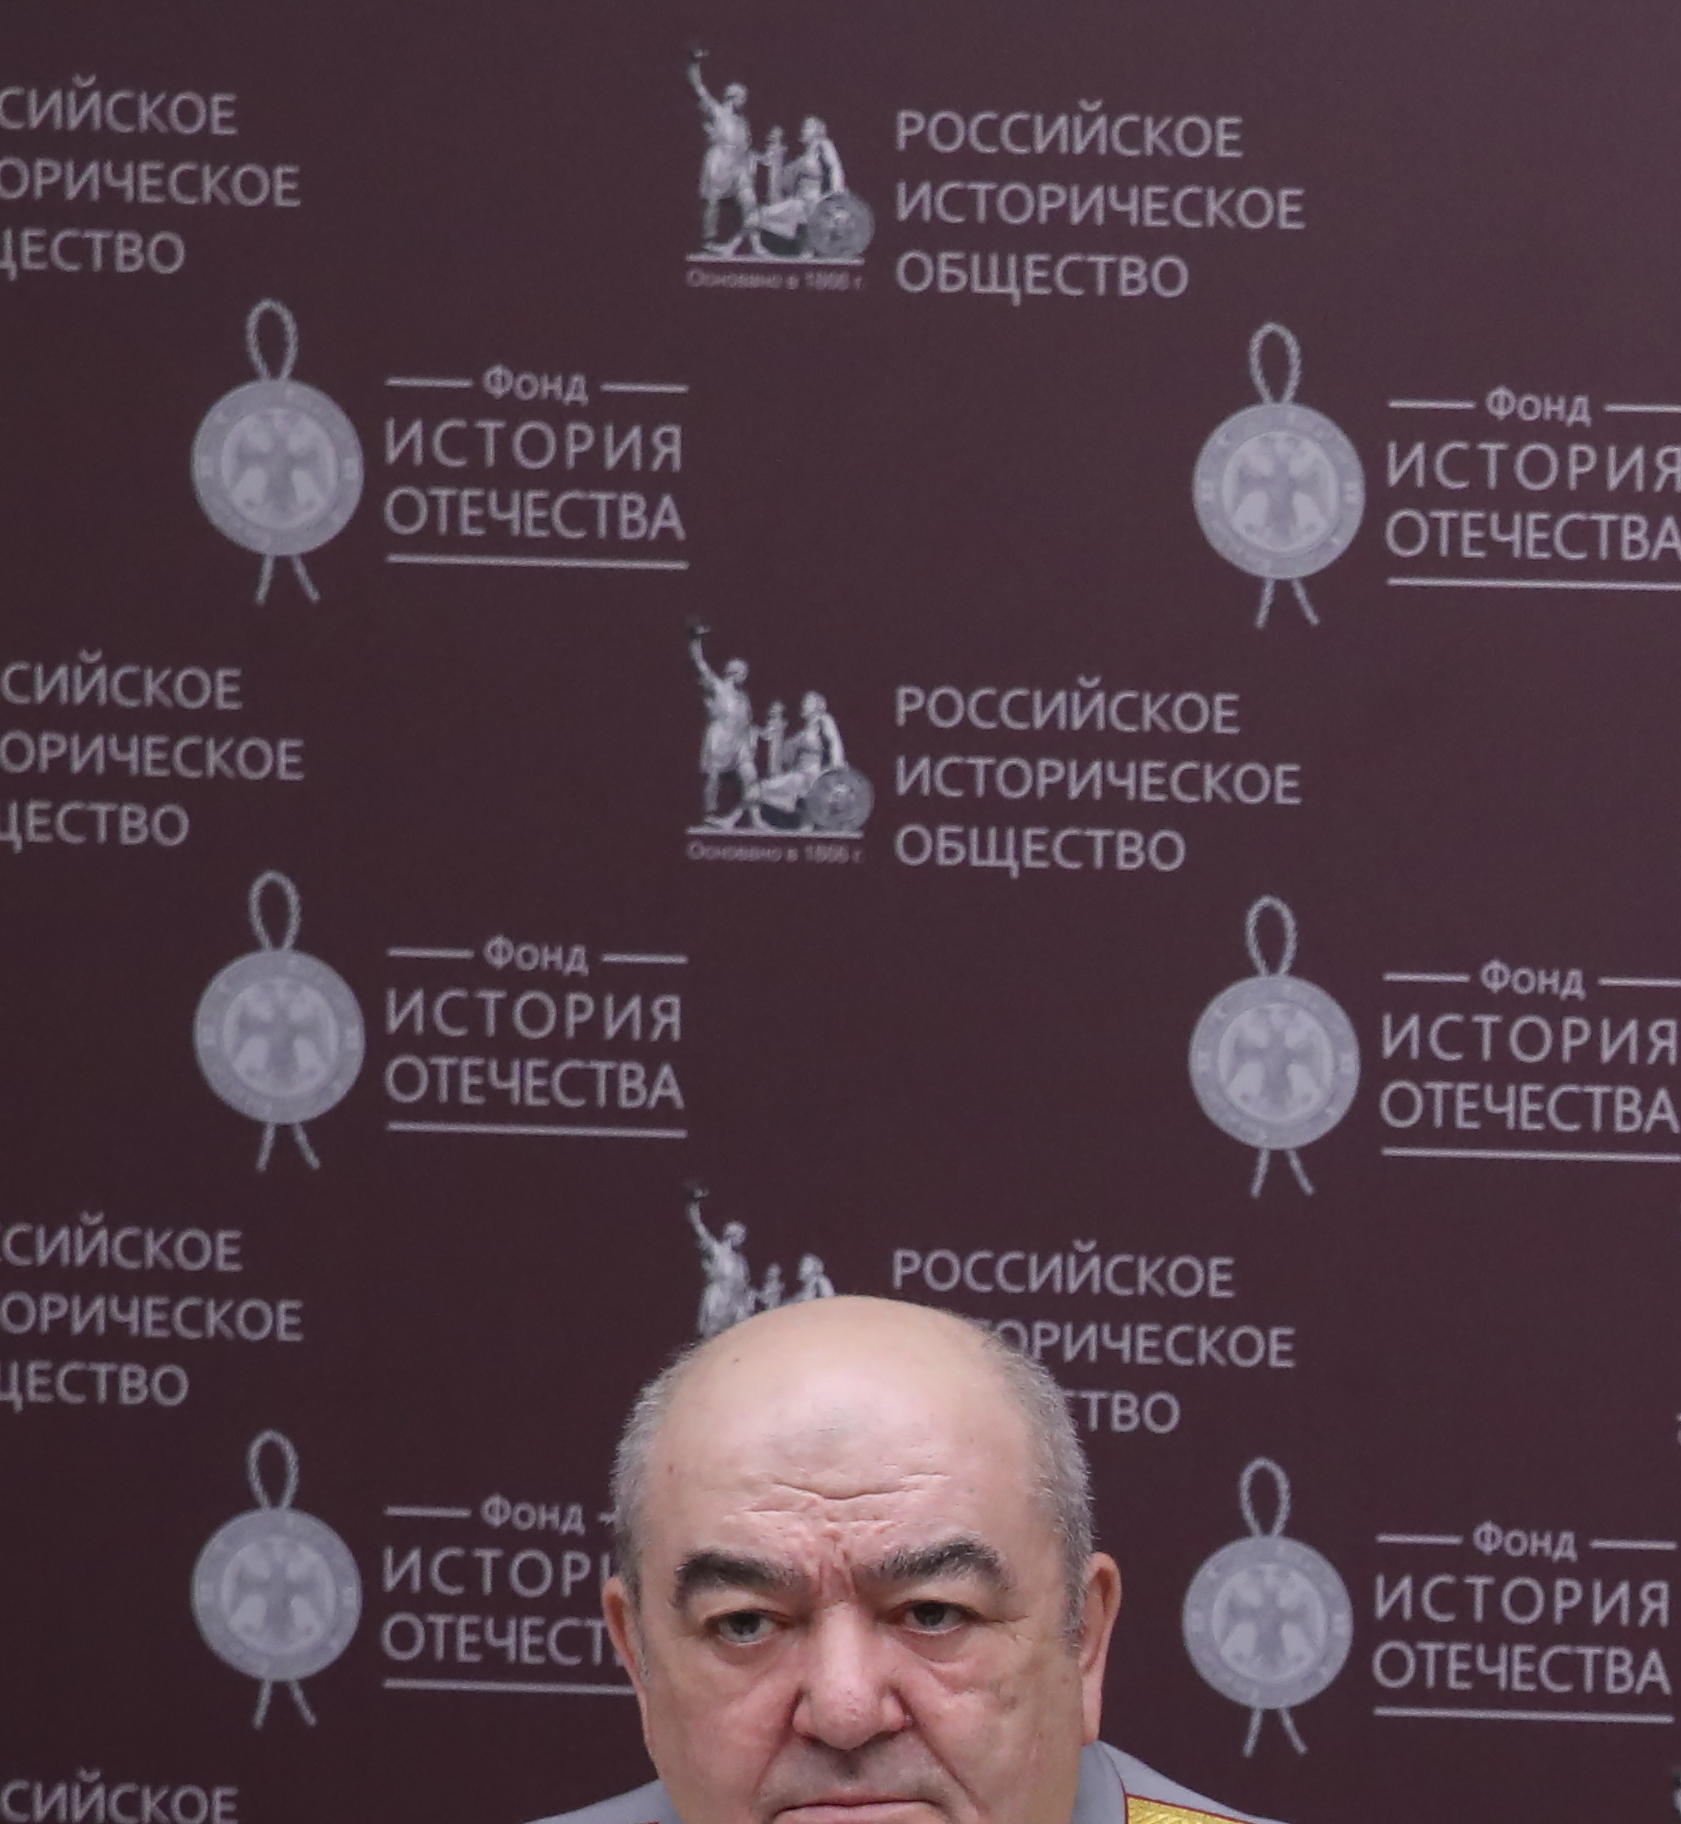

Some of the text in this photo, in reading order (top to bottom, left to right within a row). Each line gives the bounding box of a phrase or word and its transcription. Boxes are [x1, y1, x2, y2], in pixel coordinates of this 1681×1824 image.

[0, 75, 237, 135] СИЙСКОЕ
[896, 99, 1243, 158] РОССИЙСКОЕ
[0, 157, 300, 207] ОРИЧЕСКОЕ
[896, 181, 1305, 230] ИСТОРИЧЕСКОЕ
[0, 228, 185, 280] ЕСТВО
[895, 250, 1189, 306] ОБЩЕСТВО
[483, 364, 589, 405] Фонд
[1485, 385, 1592, 427] Фонд
[385, 418, 682, 471] ИСТОРИЯ
[384, 486, 685, 540] ОТЕЧЕСТВА
[0, 650, 241, 710] СИЙСКОЕ
[896, 675, 1240, 735] РОССИЙСКОЕ
[0, 730, 304, 781] ОРИЧЕСКОЕ
[896, 755, 1301, 805] ИСТОРИЧЕСКОЕ
[0, 800, 189, 853] ЕСТВО
[894, 823, 1186, 879] ОБЩЕСТВО
[483, 935, 589, 976] Фонд
[1480, 959, 1586, 1000] Фонд
[386, 988, 681, 1041] ИСТОРИЯ
[1382, 1013, 1678, 1065] ИСТОРИЯ
[384, 1054, 684, 1109] ОТЕЧЕСТВА
[1379, 1079, 1681, 1134] ОТЕЧЕСТВА
[1, 1212, 242, 1272] СИЙСКОЕ
[893, 1239, 1235, 1298] РОССИЙСКОЕ
[0, 1291, 303, 1342] ОРИЧЕСКОЕ
[974, 1317, 1297, 1369] ОРИЧЕСКОЕ
[0, 1360, 189, 1412] ЕСТВО
[481, 1494, 584, 1534] Фонд
[1473, 1520, 1578, 1562] Фонд
[382, 1546, 612, 1598] ИСТОР
[1375, 1574, 1670, 1627] ИСТОРИЯ
[380, 1611, 626, 1668] ОТЕЧЕСТ
[1372, 1640, 1672, 1695] ОТЕЧЕСТВА
